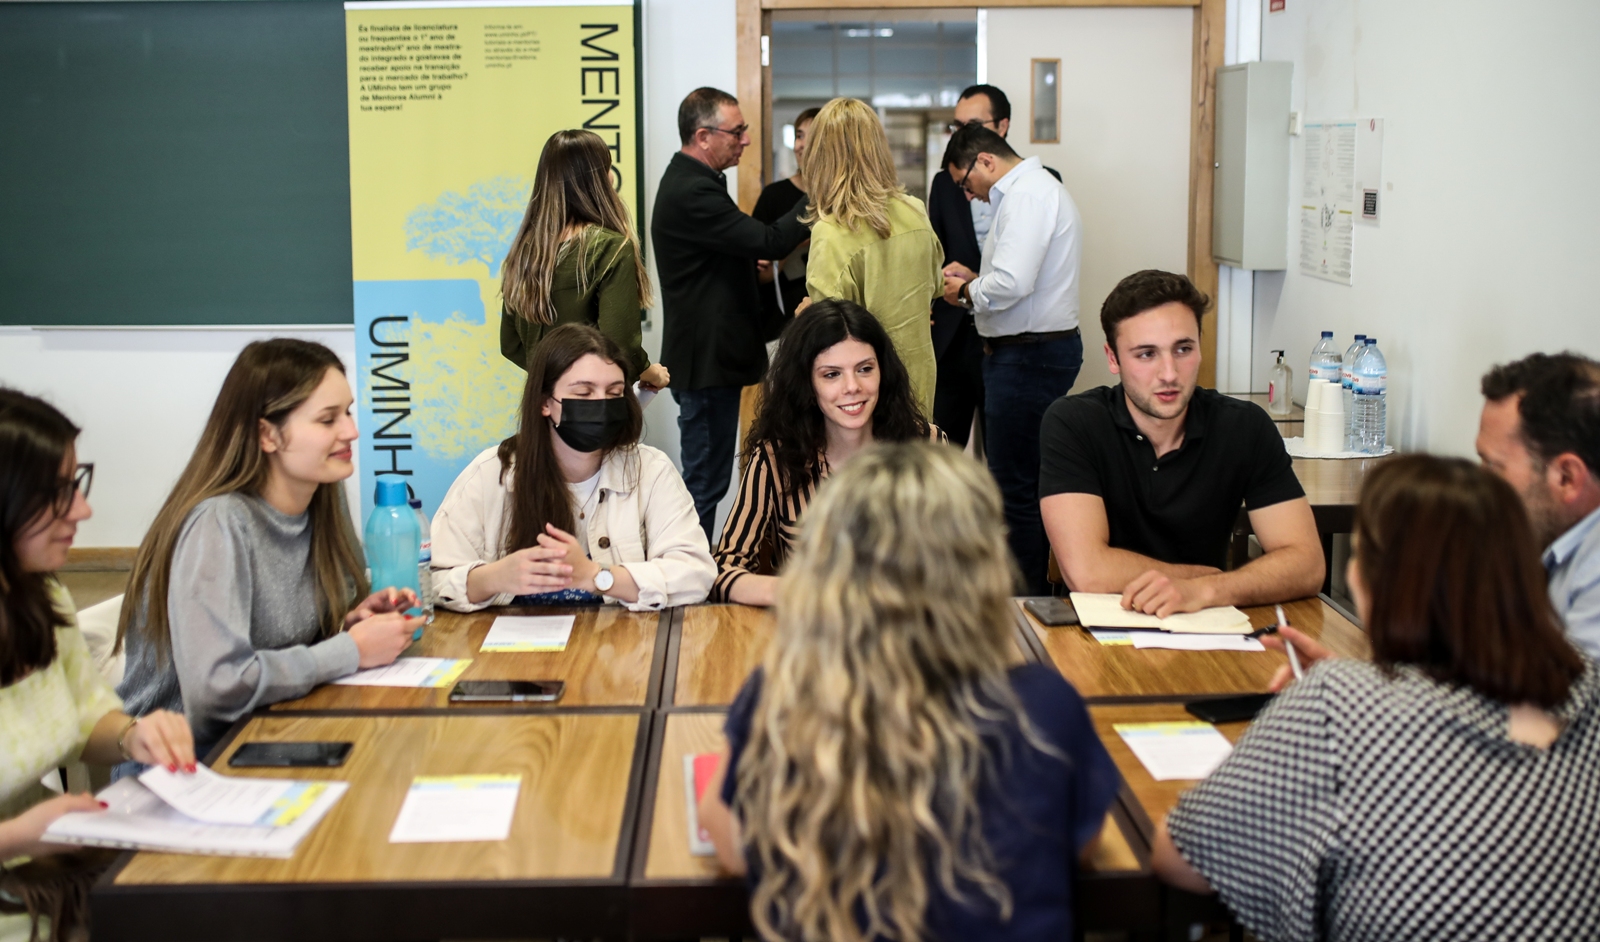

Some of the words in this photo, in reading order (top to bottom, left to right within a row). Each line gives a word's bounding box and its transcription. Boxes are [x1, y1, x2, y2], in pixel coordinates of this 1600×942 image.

[370, 35, 411, 43] frequentas
[371, 54, 407, 62] integrado
[415, 54, 450, 62] gostavas
[424, 63, 460, 71] transição
[374, 104, 403, 112] espera!
